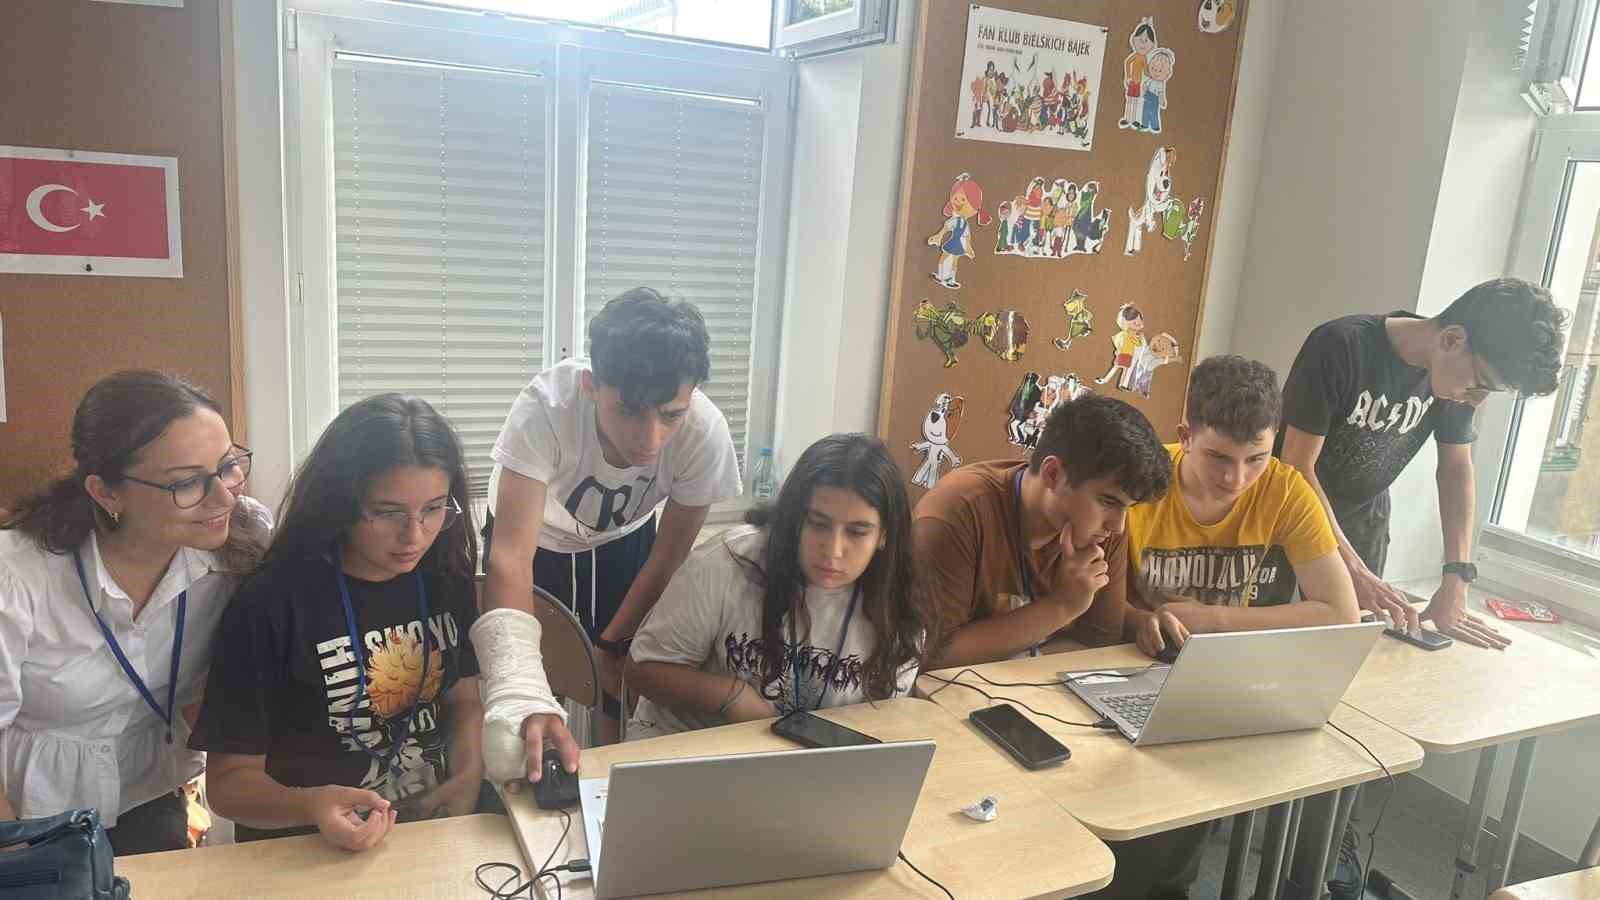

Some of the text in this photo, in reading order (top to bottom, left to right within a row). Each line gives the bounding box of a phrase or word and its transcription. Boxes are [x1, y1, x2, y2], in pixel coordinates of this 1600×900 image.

[977, 24, 996, 40] FAN
[998, 27, 1021, 44] KLUB
[1067, 38, 1091, 57] BAJEK
